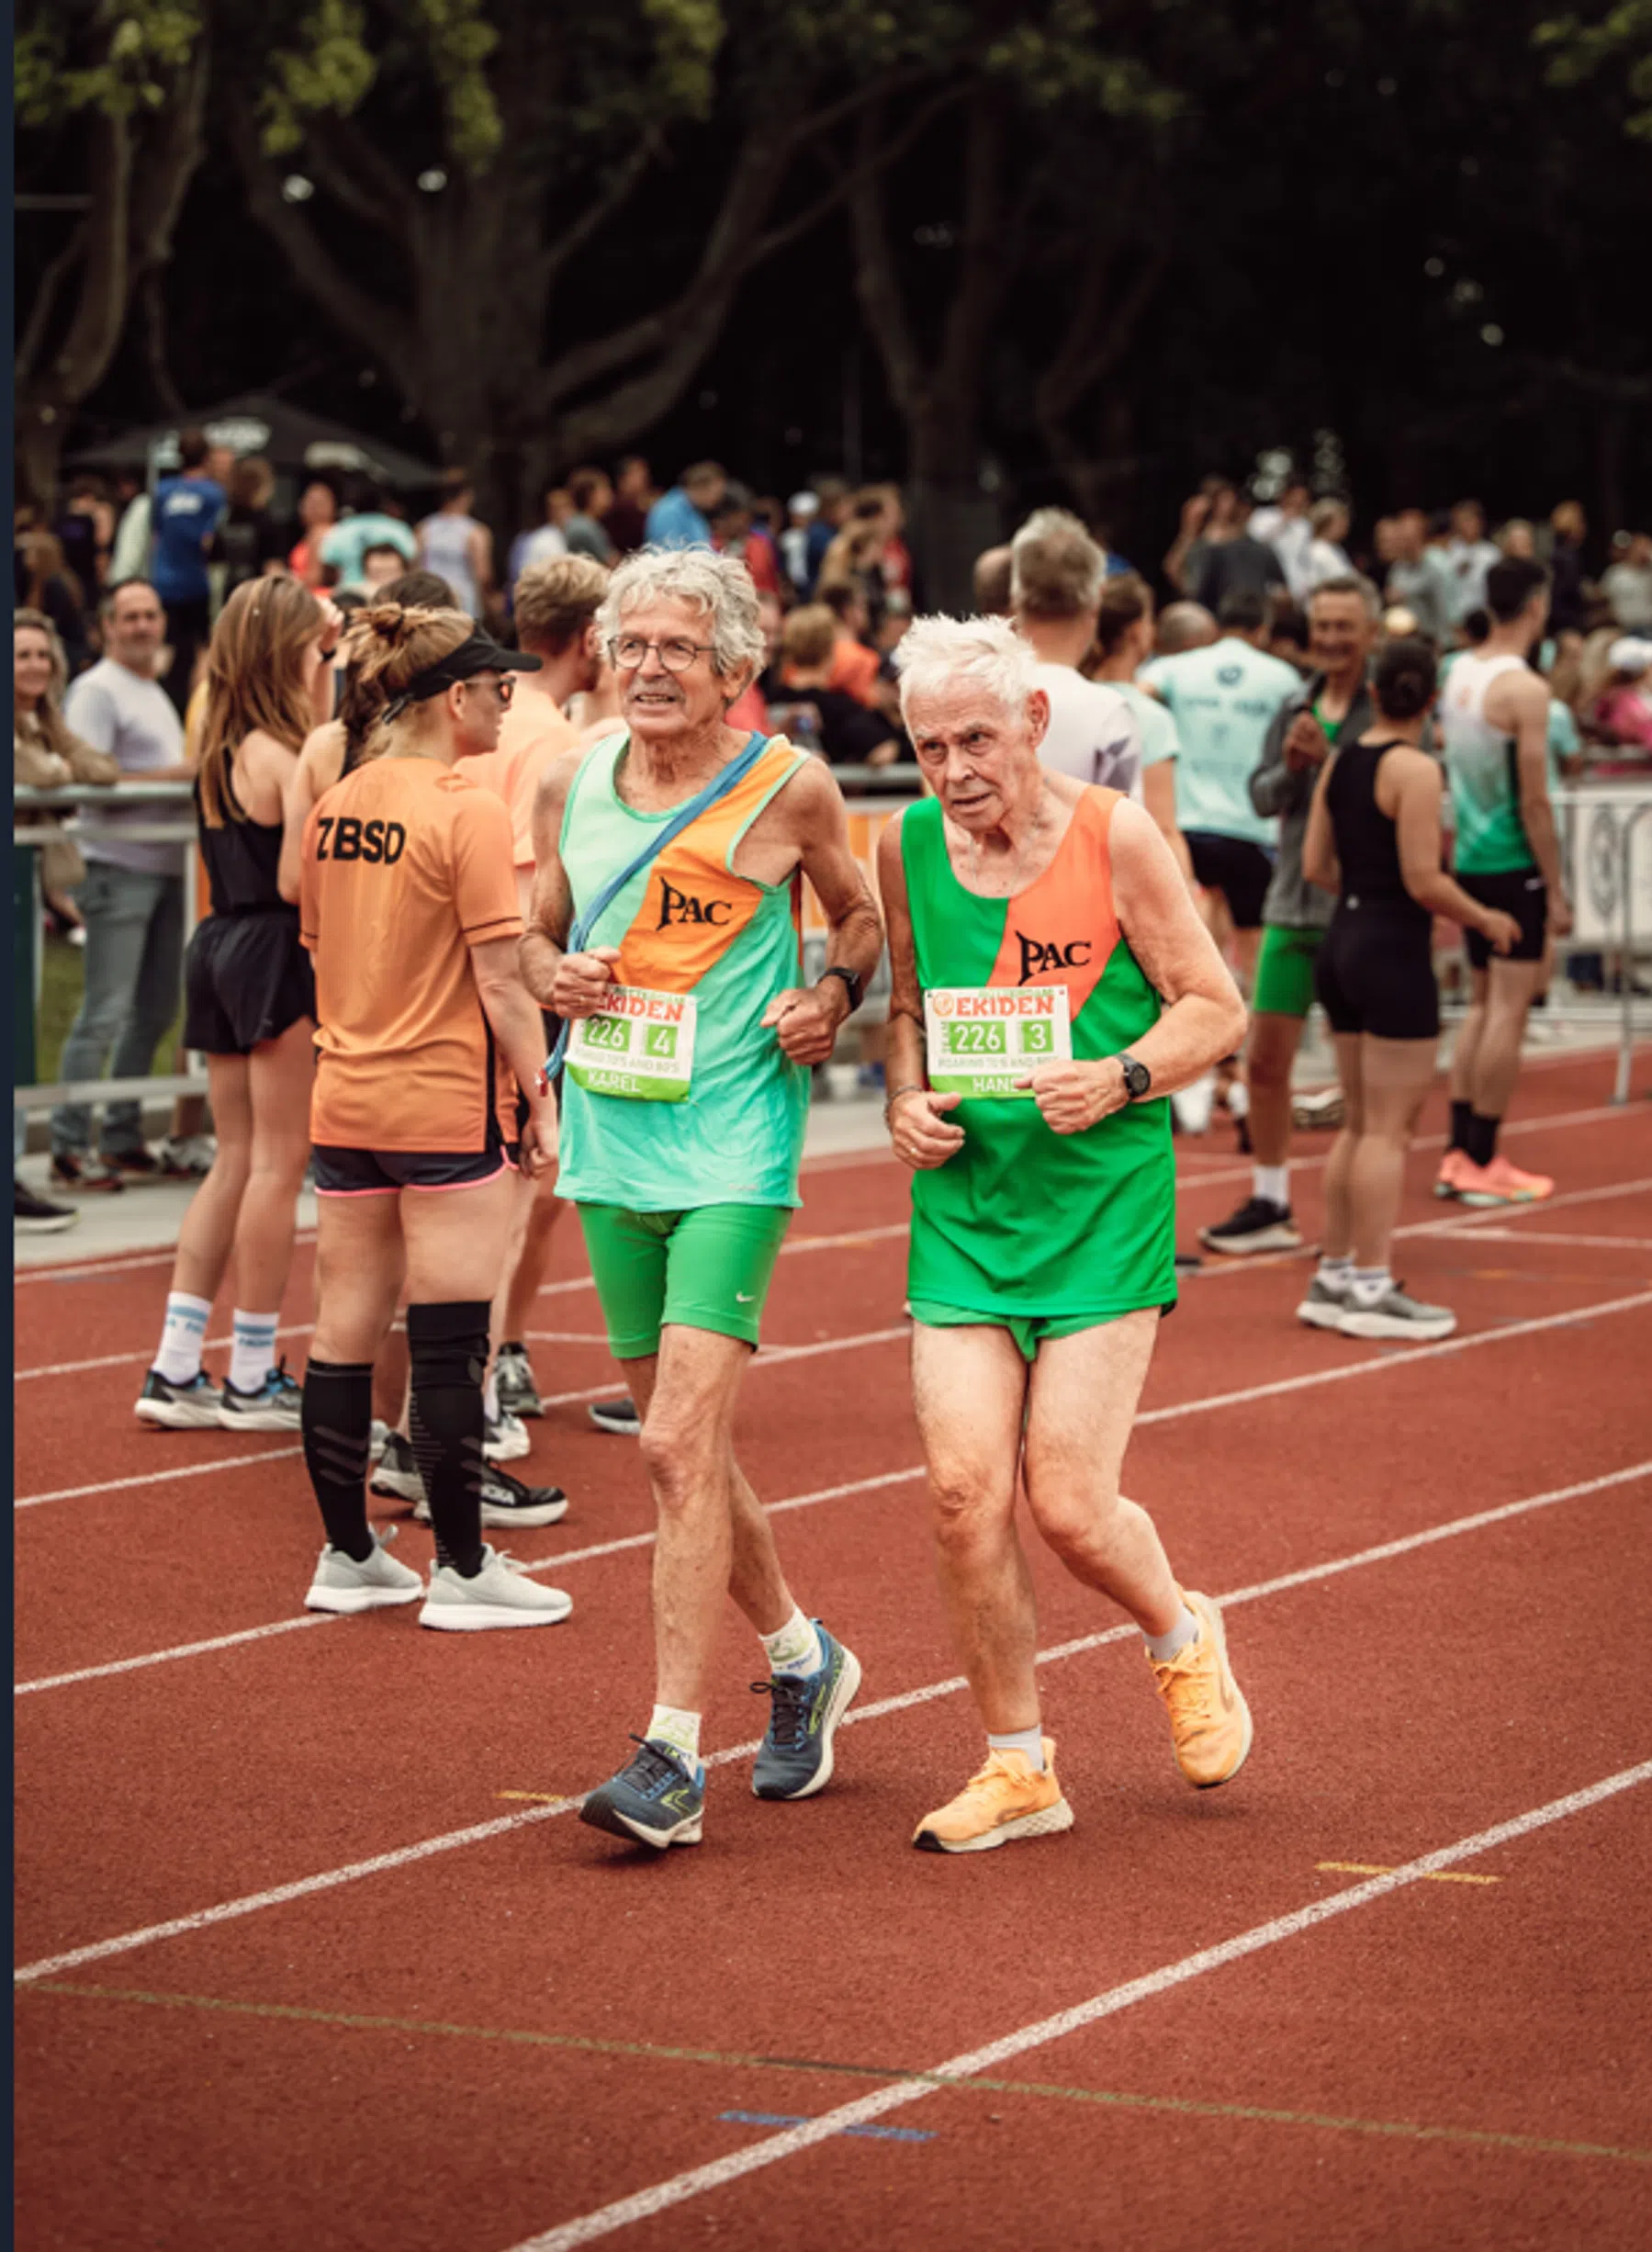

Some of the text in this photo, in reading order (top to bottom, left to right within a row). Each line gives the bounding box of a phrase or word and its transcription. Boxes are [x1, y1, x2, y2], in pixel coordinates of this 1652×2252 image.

[317, 816, 406, 865] ZBSD
[656, 875, 732, 931] PAC
[1015, 929, 1092, 986] PAC
[956, 995, 1054, 1017] EKIDEN
[588, 1018, 624, 1048] 226
[653, 1029, 670, 1054] 4
[954, 1023, 1002, 1052] 226
[1029, 1023, 1047, 1050] 3
[587, 1068, 641, 1093] KAREL
